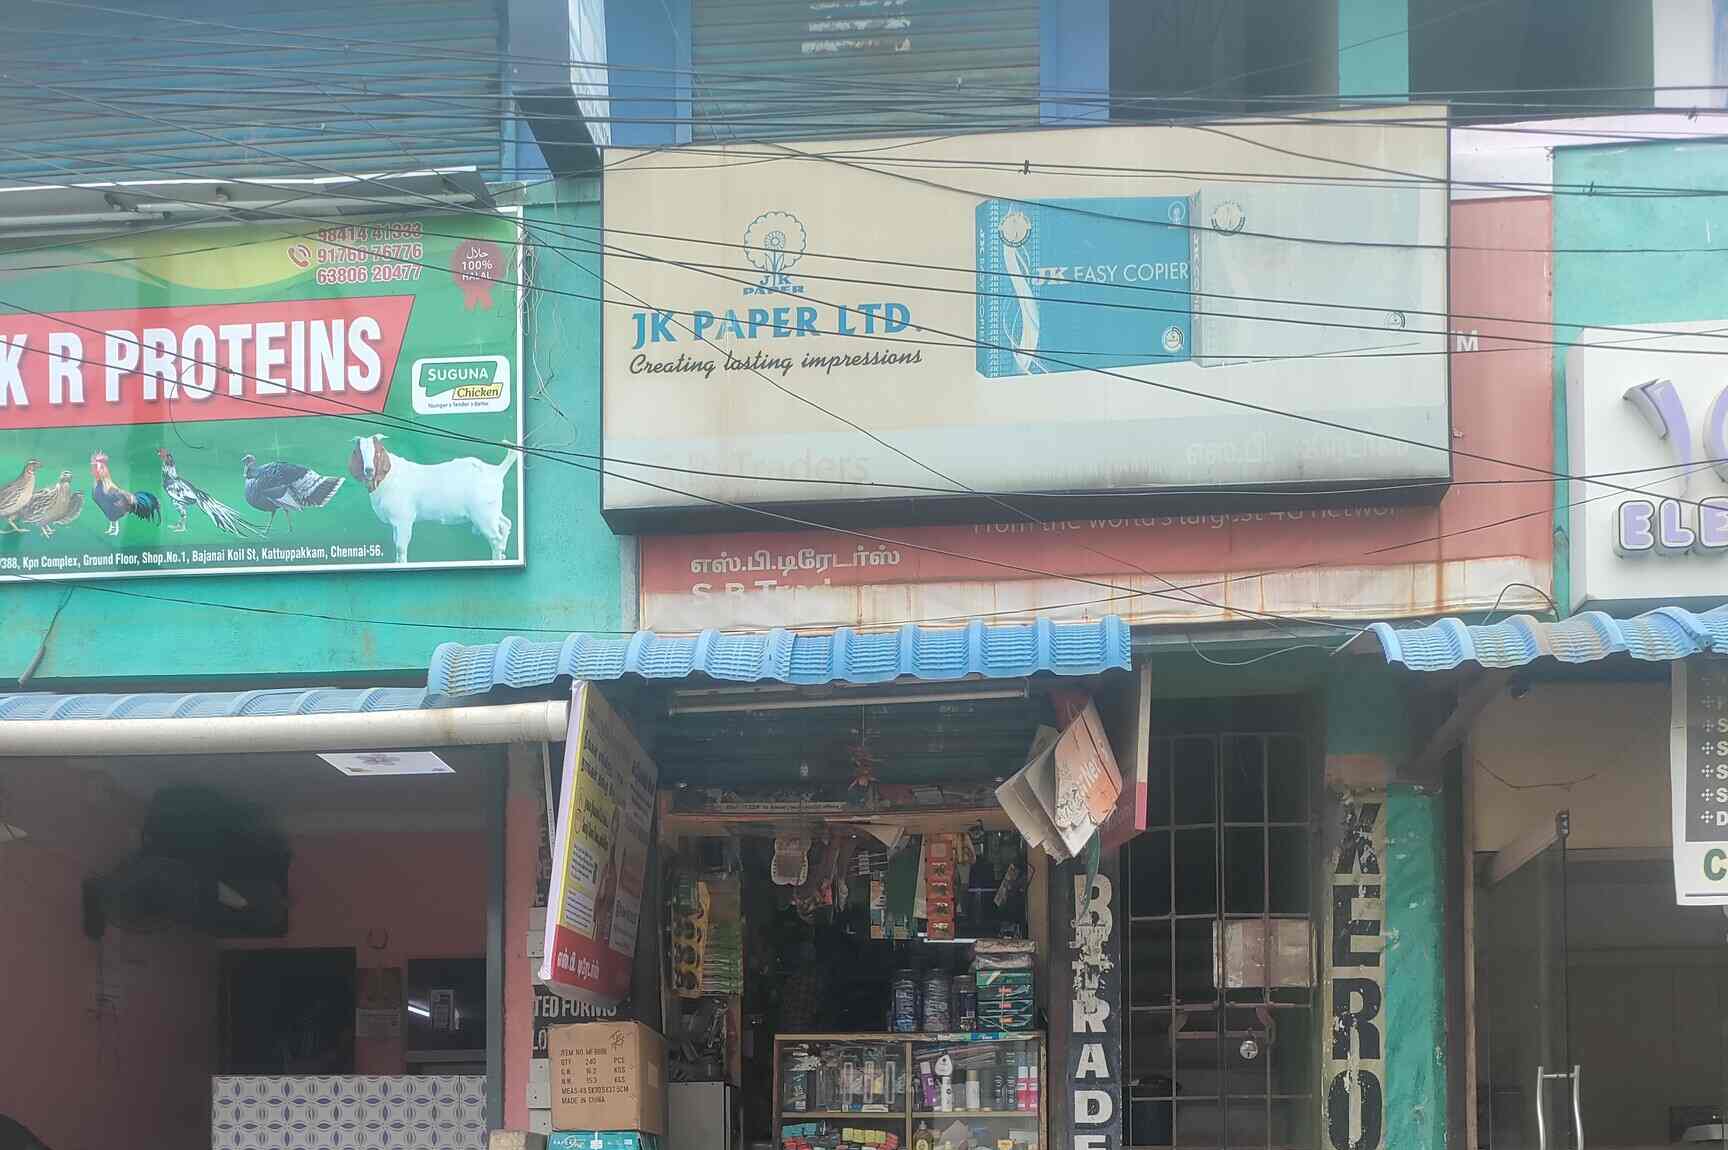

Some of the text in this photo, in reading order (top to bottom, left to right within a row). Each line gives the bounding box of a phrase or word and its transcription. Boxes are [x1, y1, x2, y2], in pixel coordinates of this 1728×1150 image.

[317, 263, 422, 285] 63806 20477
[461, 260, 493, 271] 100%
[1074, 264, 1118, 283] EASY
[1123, 261, 1189, 282] COPIER
[743, 285, 805, 296] PAPER
[632, 311, 677, 350] JK
[694, 306, 821, 342] PAPER
[49, 332, 84, 403] R
[105, 316, 382, 402] PROTEINS
[629, 348, 923, 379] Creating lasting impressions
[428, 368, 488, 381] SUGUNA
[457, 387, 499, 398] Chicken
[23, 556, 39, 570] Kpn
[41, 555, 81, 570] Complex,
[83, 553, 113, 566] Ground
[116, 552, 140, 566] Floor,
[192, 548, 224, 564] Bajanai
[227, 548, 245, 561] Koil
[246, 547, 259, 561] St,
